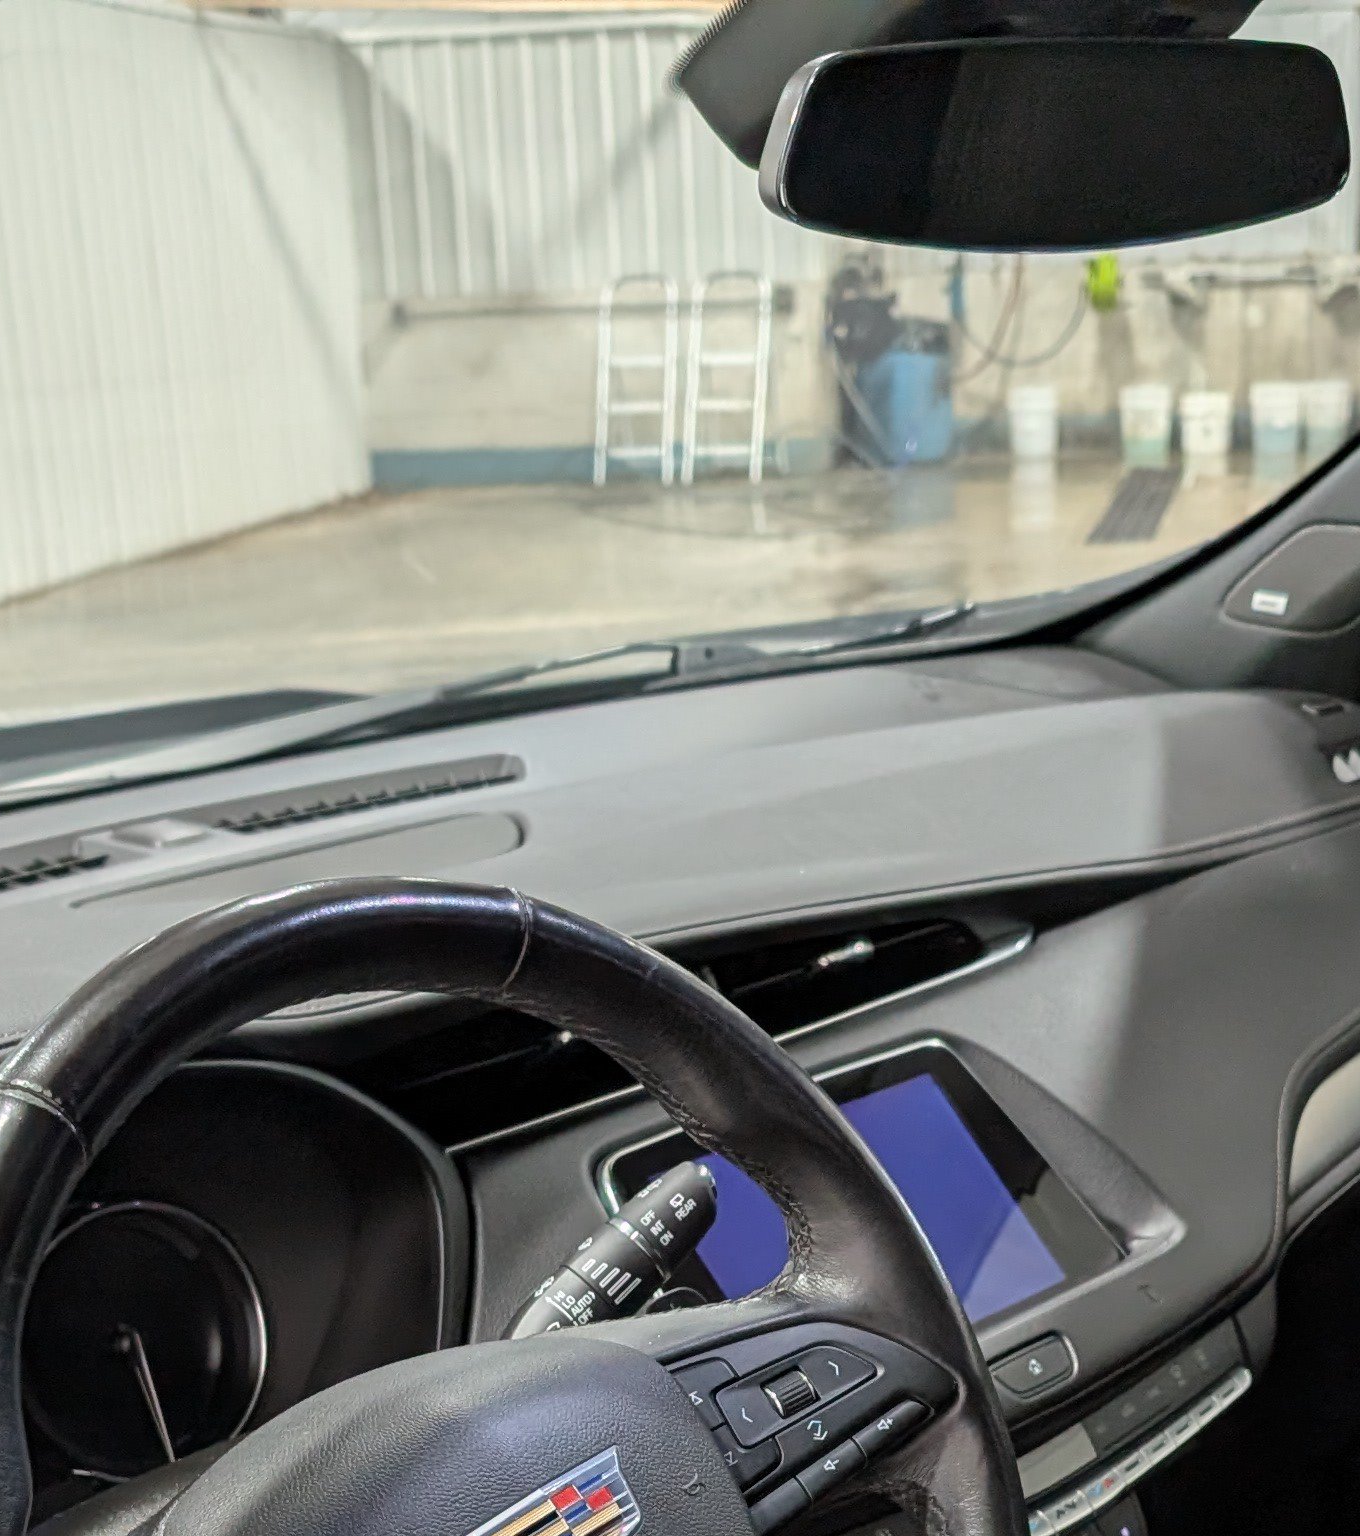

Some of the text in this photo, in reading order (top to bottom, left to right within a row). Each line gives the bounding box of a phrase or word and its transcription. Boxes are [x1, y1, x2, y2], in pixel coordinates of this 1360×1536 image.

[640, 1209, 656, 1227] OFF
[674, 1198, 697, 1222] REAR
[650, 1219, 665, 1236] INT
[659, 1230, 674, 1246] ON
[562, 1294, 576, 1310] LO
